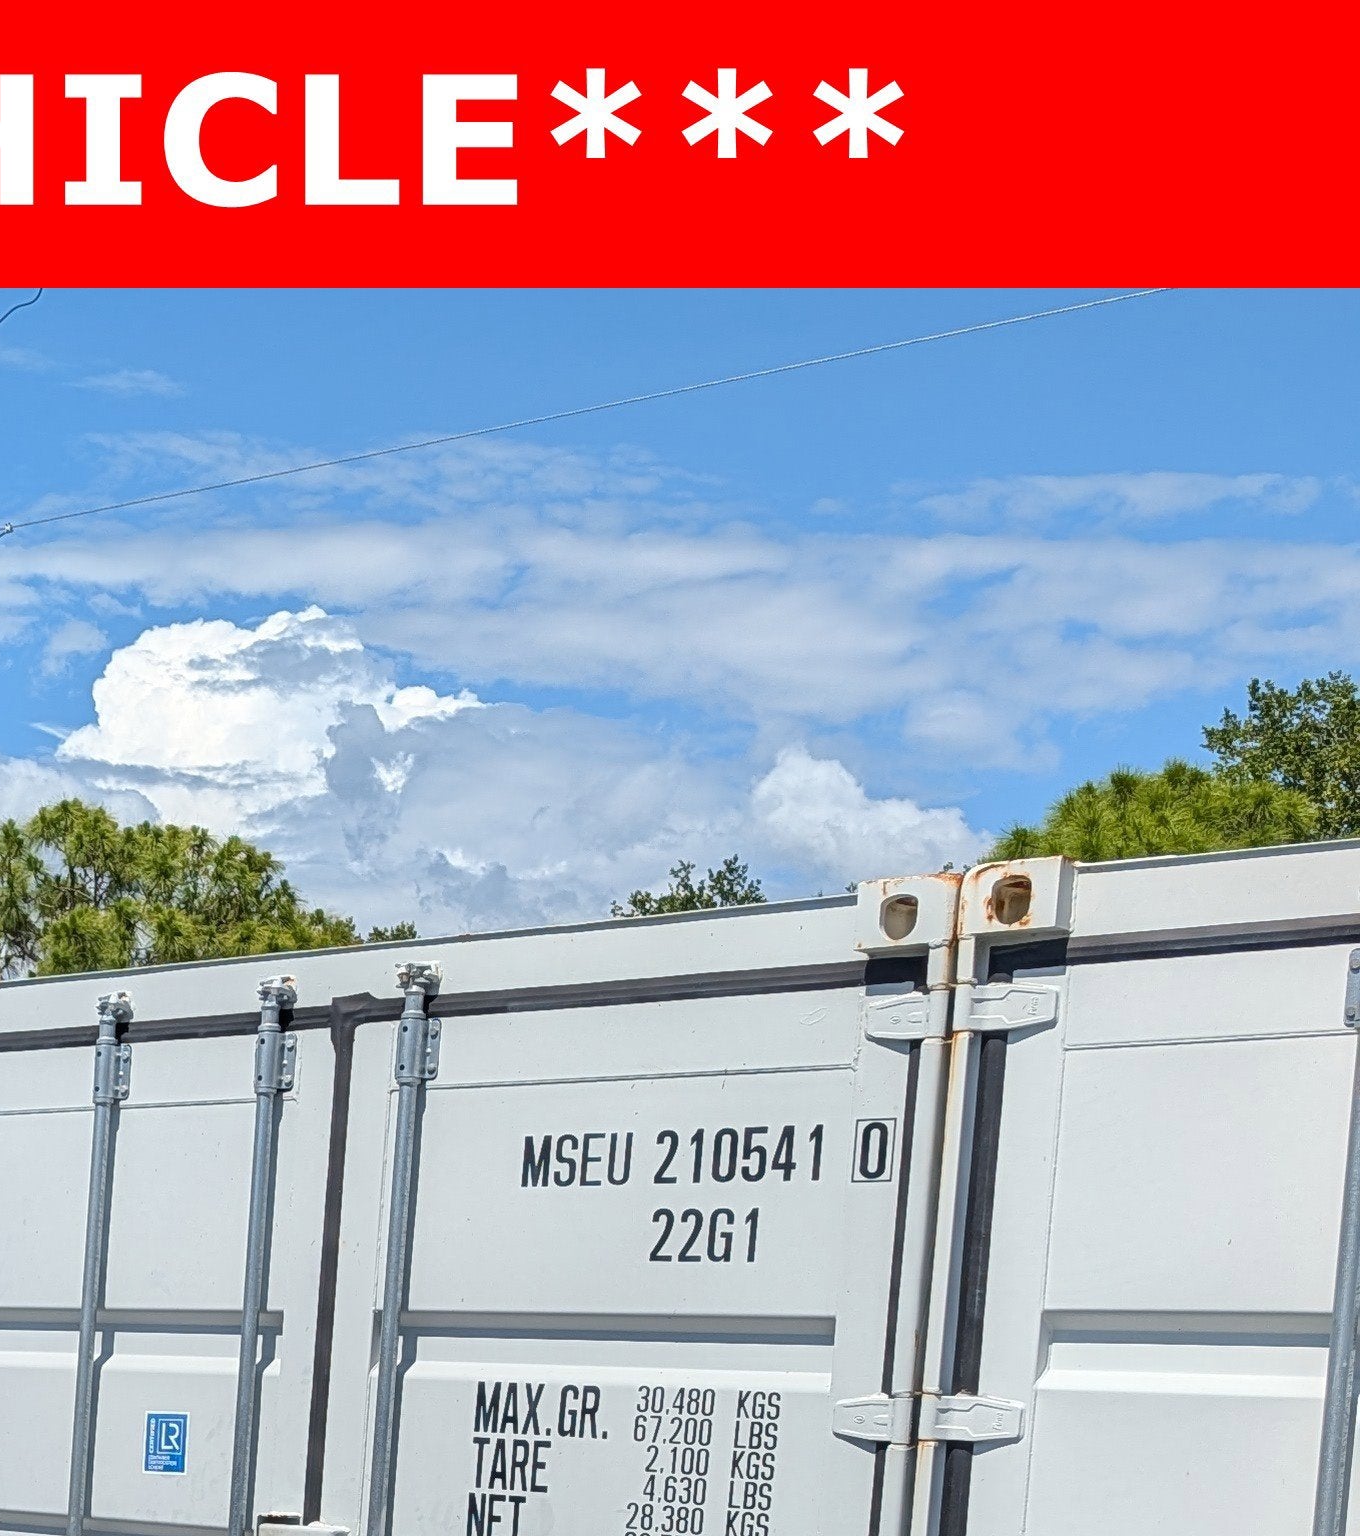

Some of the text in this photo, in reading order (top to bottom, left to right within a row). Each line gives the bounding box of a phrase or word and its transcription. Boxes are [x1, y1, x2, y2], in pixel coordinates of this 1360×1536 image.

[521, 1122, 889, 1187] MSEU 210541 0
[649, 1207, 760, 1263] 22G1
[736, 1390, 781, 1420] KGS
[161, 1423, 180, 1451] LR
[734, 1420, 778, 1450] LBS
[473, 1437, 552, 1493] TARE
[731, 1450, 776, 1480] KGS
[728, 1481, 772, 1511] LBS
